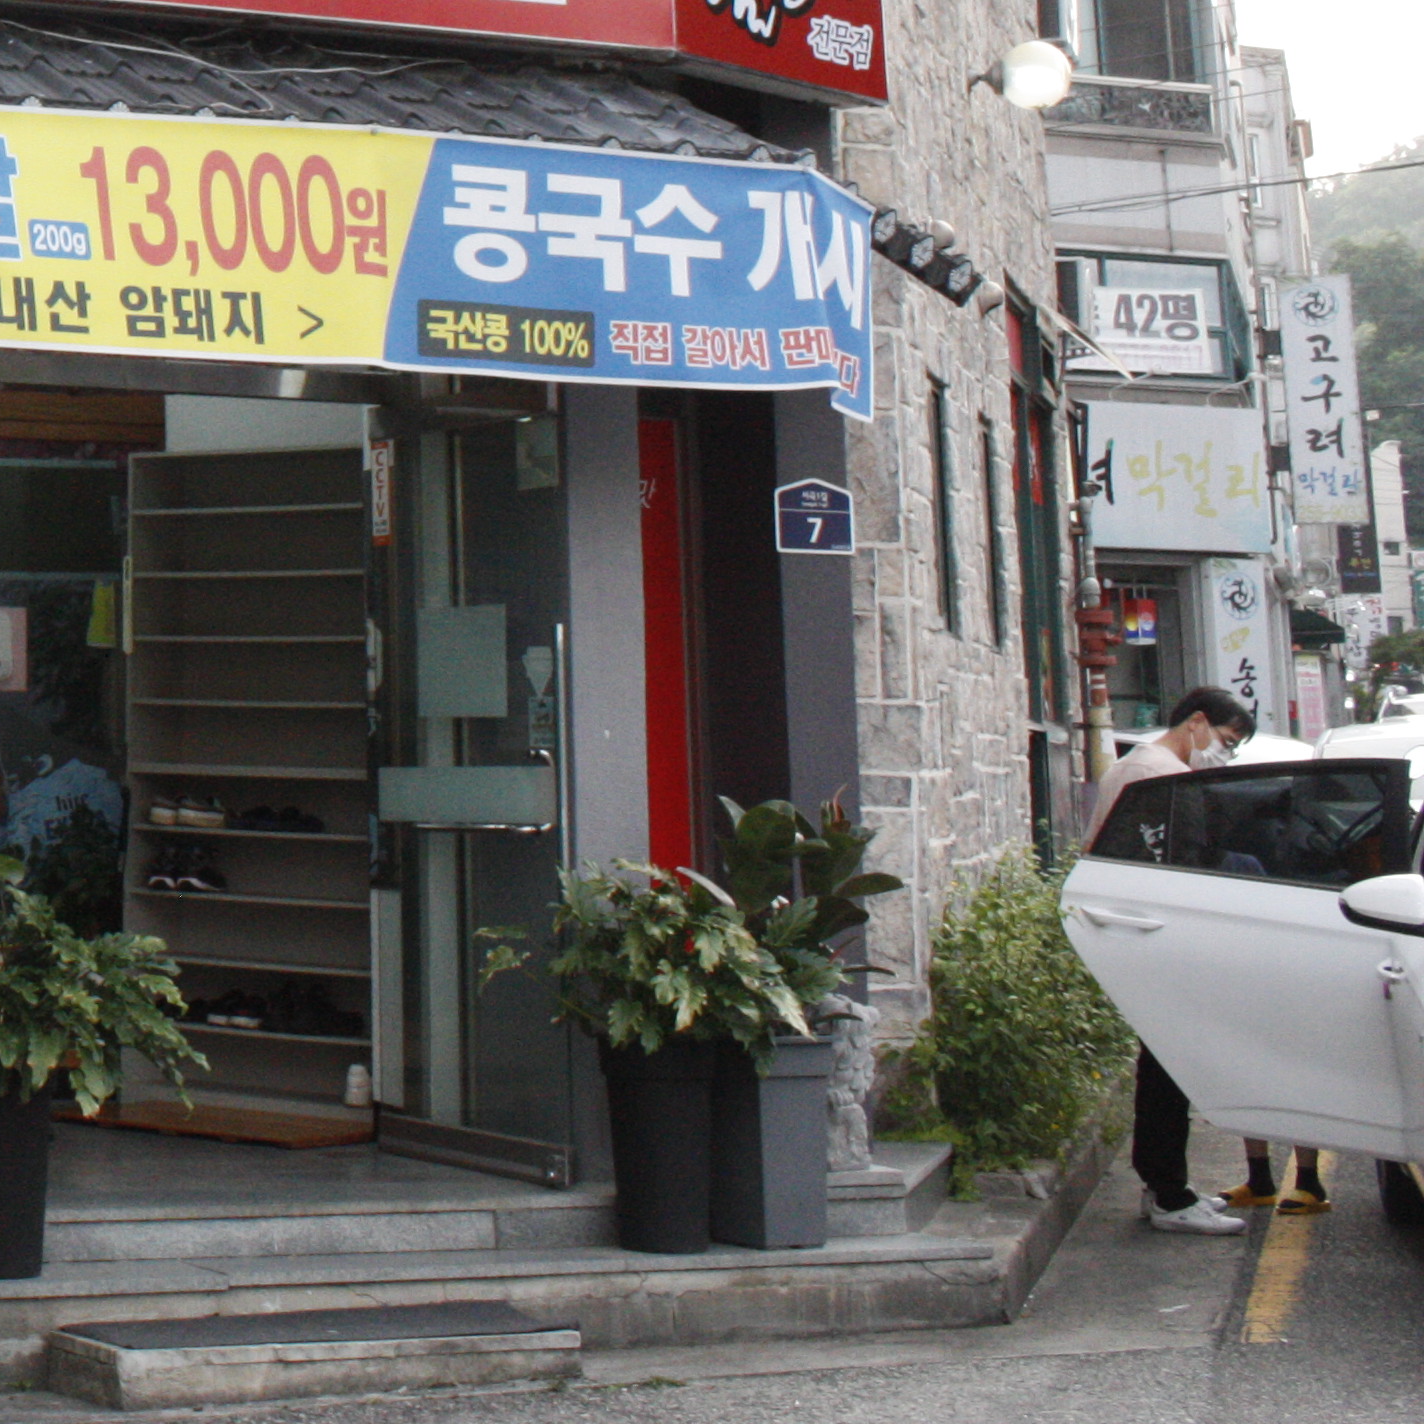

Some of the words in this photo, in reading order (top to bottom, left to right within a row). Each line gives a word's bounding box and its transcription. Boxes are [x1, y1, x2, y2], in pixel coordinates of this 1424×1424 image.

[808, 19, 873, 68] 전문점
[32, 221, 87, 256] 200g
[80, 145, 389, 278] 13,000원
[443, 163, 723, 297] 콩국수
[746, 188, 865, 331] 개시
[119, 286, 265, 345] 암돼지
[426, 309, 510, 354] 국산콩
[520, 320, 589, 360] 100%
[1113, 293, 1199, 342] 42평
[609, 320, 672, 366] 직접
[682, 324, 770, 371] 갈아서
[1300, 333, 1345, 459] 고구려
[375, 451, 385, 517] CCTV
[1126, 439, 1261, 518] 막걸리
[806, 517, 822, 543] 7
